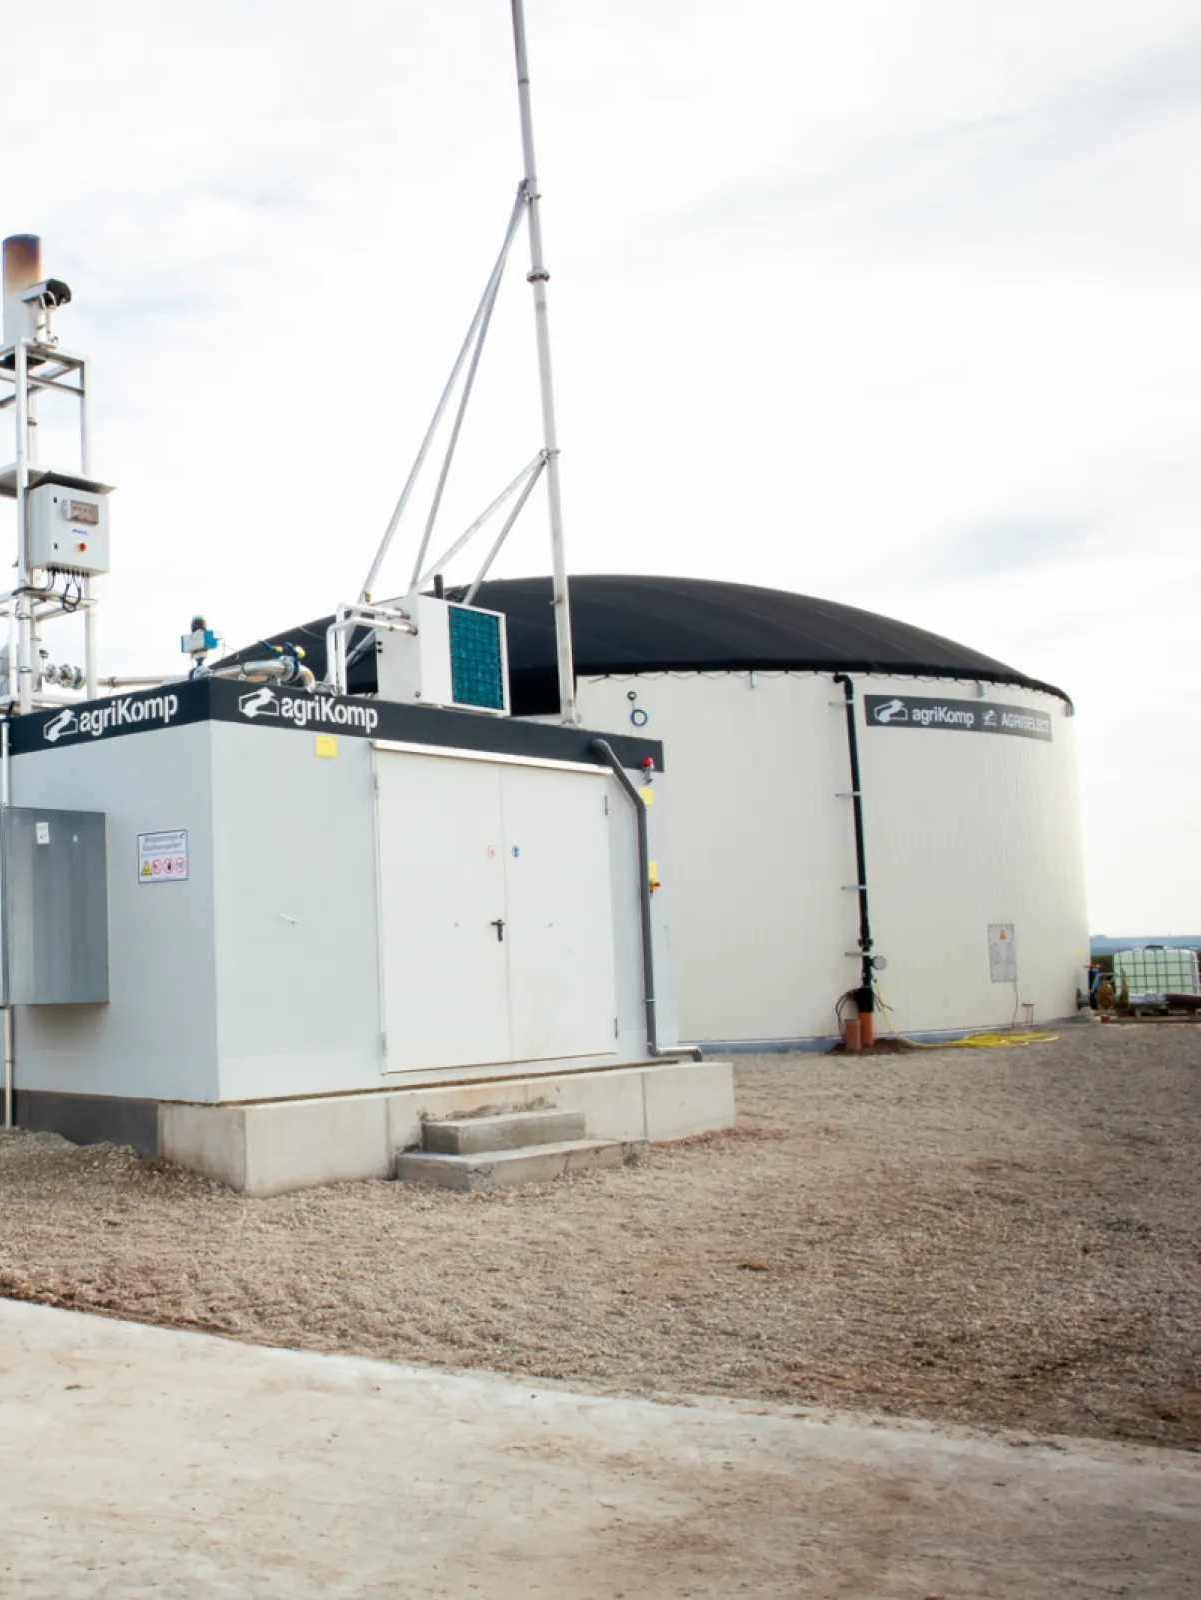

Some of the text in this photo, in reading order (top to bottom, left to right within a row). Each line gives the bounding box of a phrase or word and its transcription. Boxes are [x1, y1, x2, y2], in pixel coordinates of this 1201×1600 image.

[80, 694, 178, 736] agriKomp
[281, 694, 378, 734] agriKomp
[912, 706, 1049, 732] agriKomp AGRISELECT
